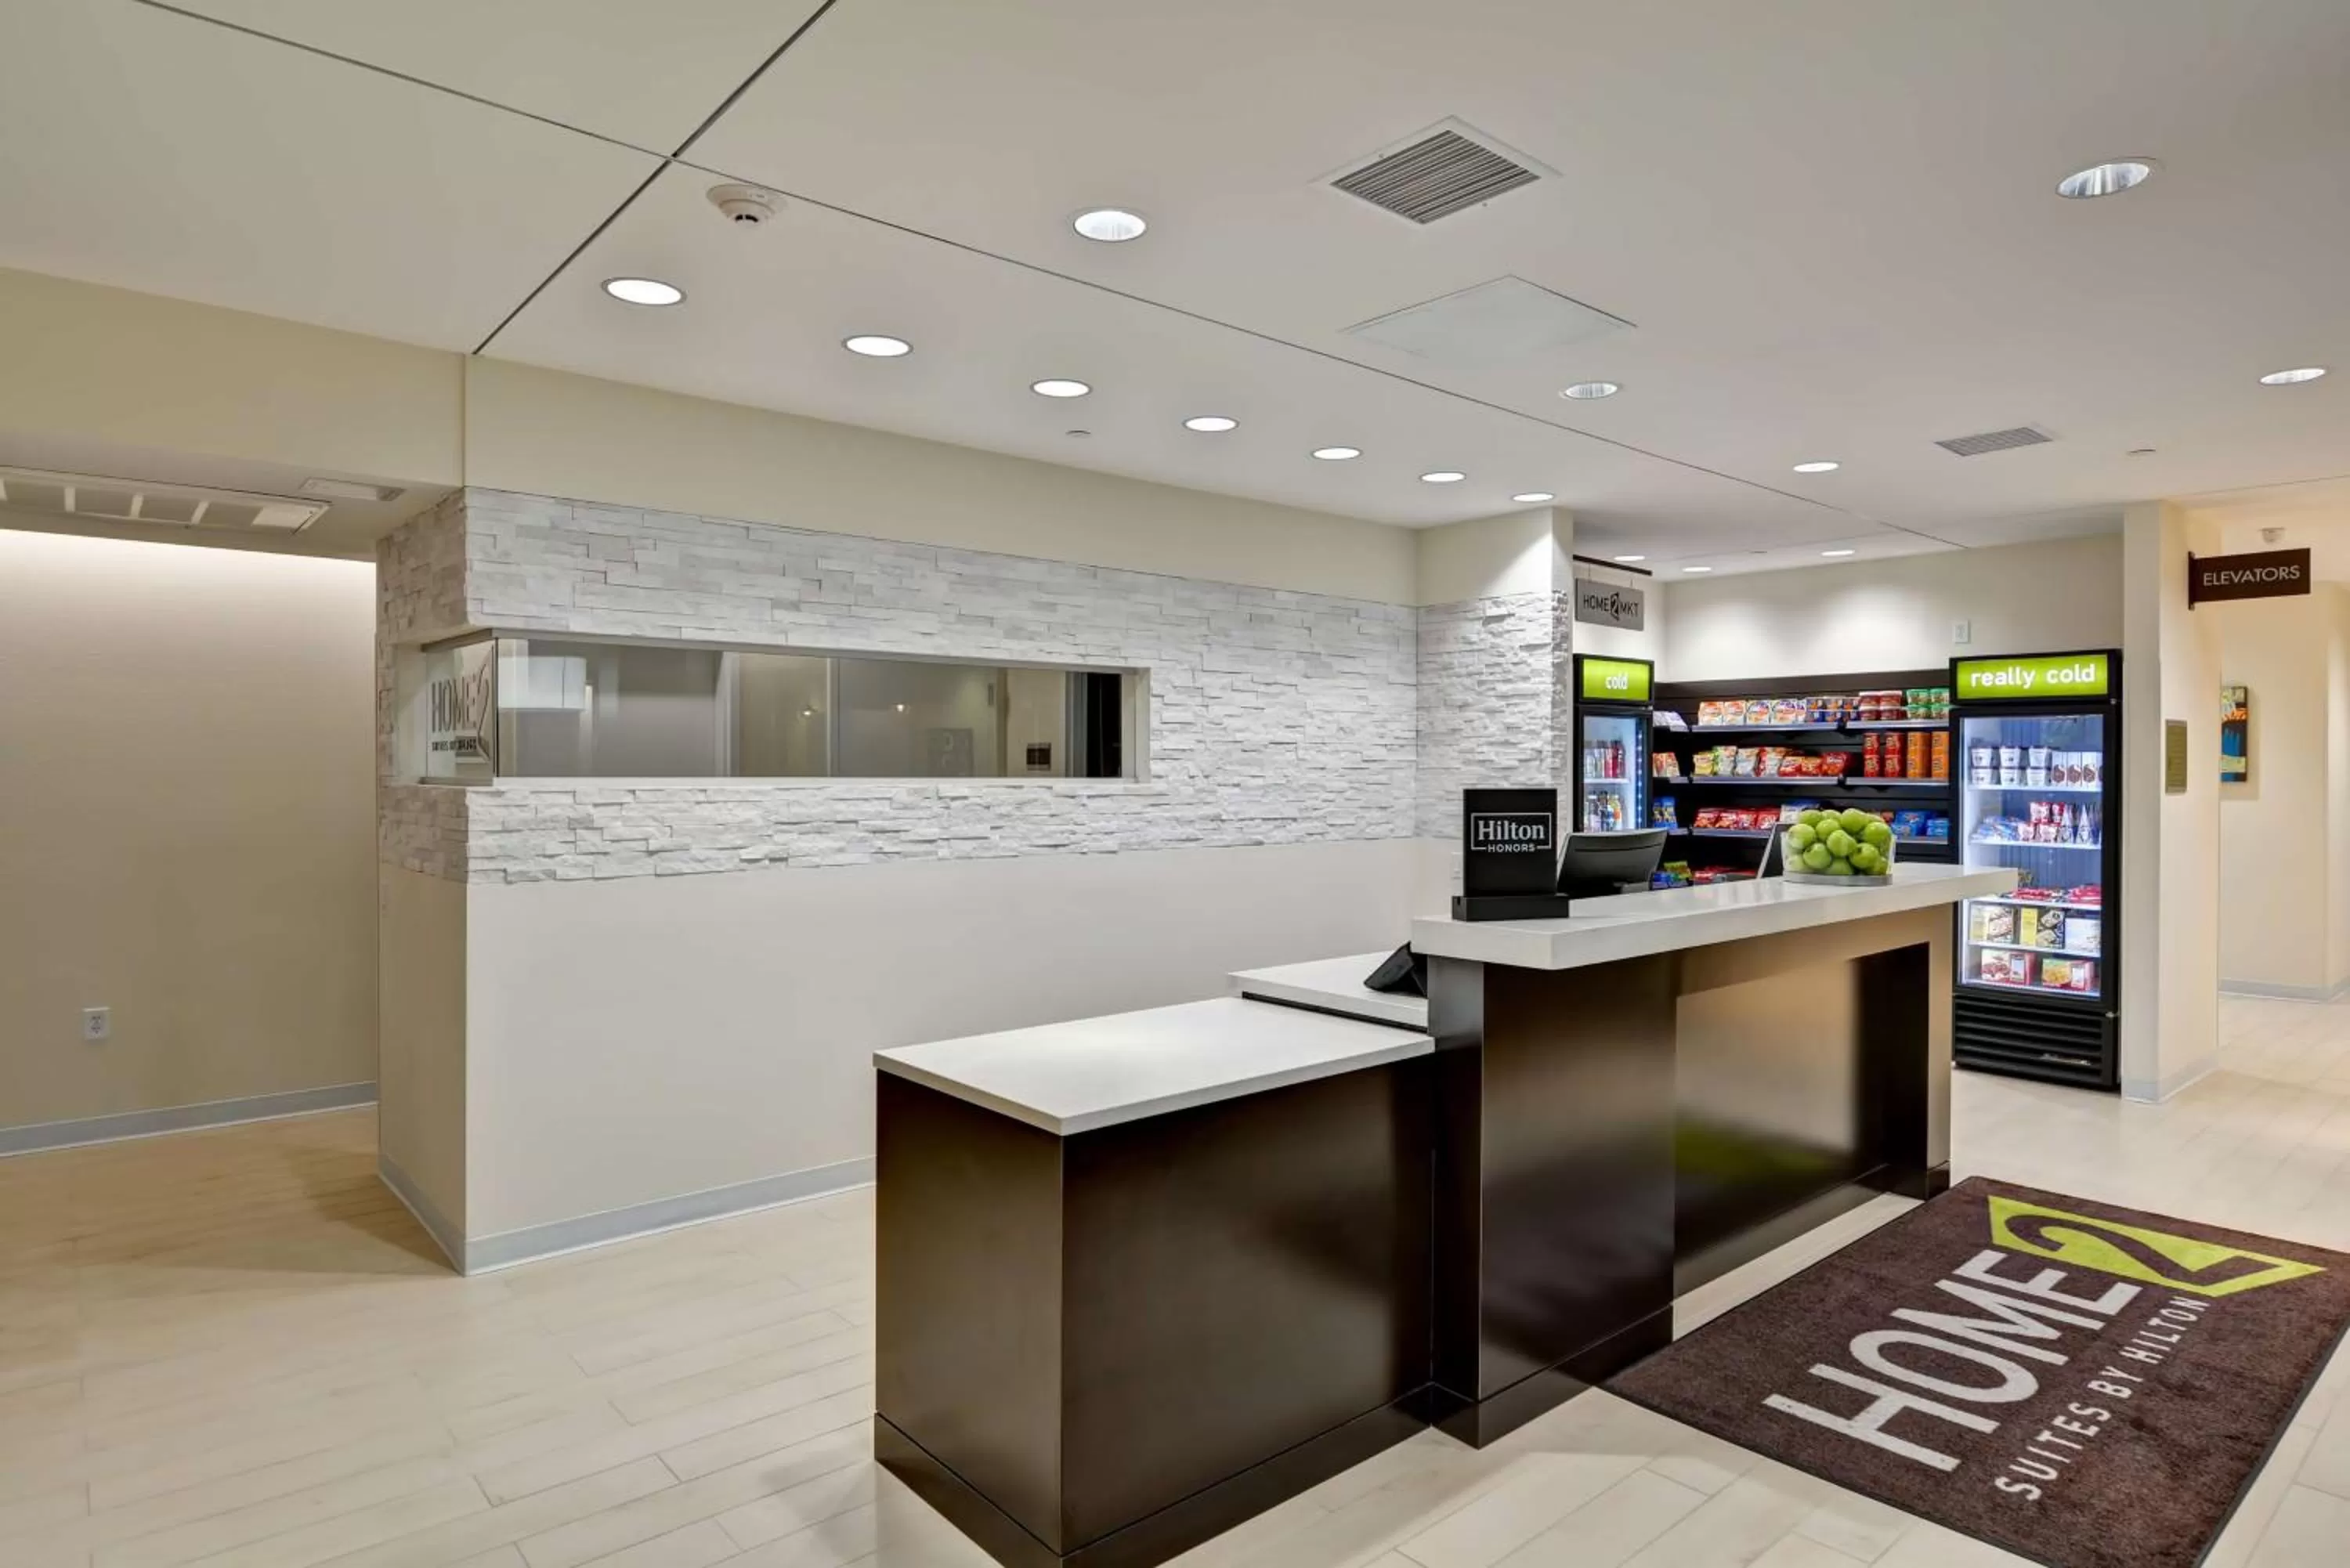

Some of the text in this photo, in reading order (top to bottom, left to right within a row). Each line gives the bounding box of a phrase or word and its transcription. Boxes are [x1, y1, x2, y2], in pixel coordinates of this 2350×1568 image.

[2203, 565, 2301, 587] ELEVATORS
[1603, 670, 1628, 690] cold
[1971, 664, 2095, 689] really cold
[1477, 820, 1546, 841] Hilton
[1488, 844, 1536, 853] HONORS
[1994, 1295, 2211, 1501] SUITES BY HILTON
